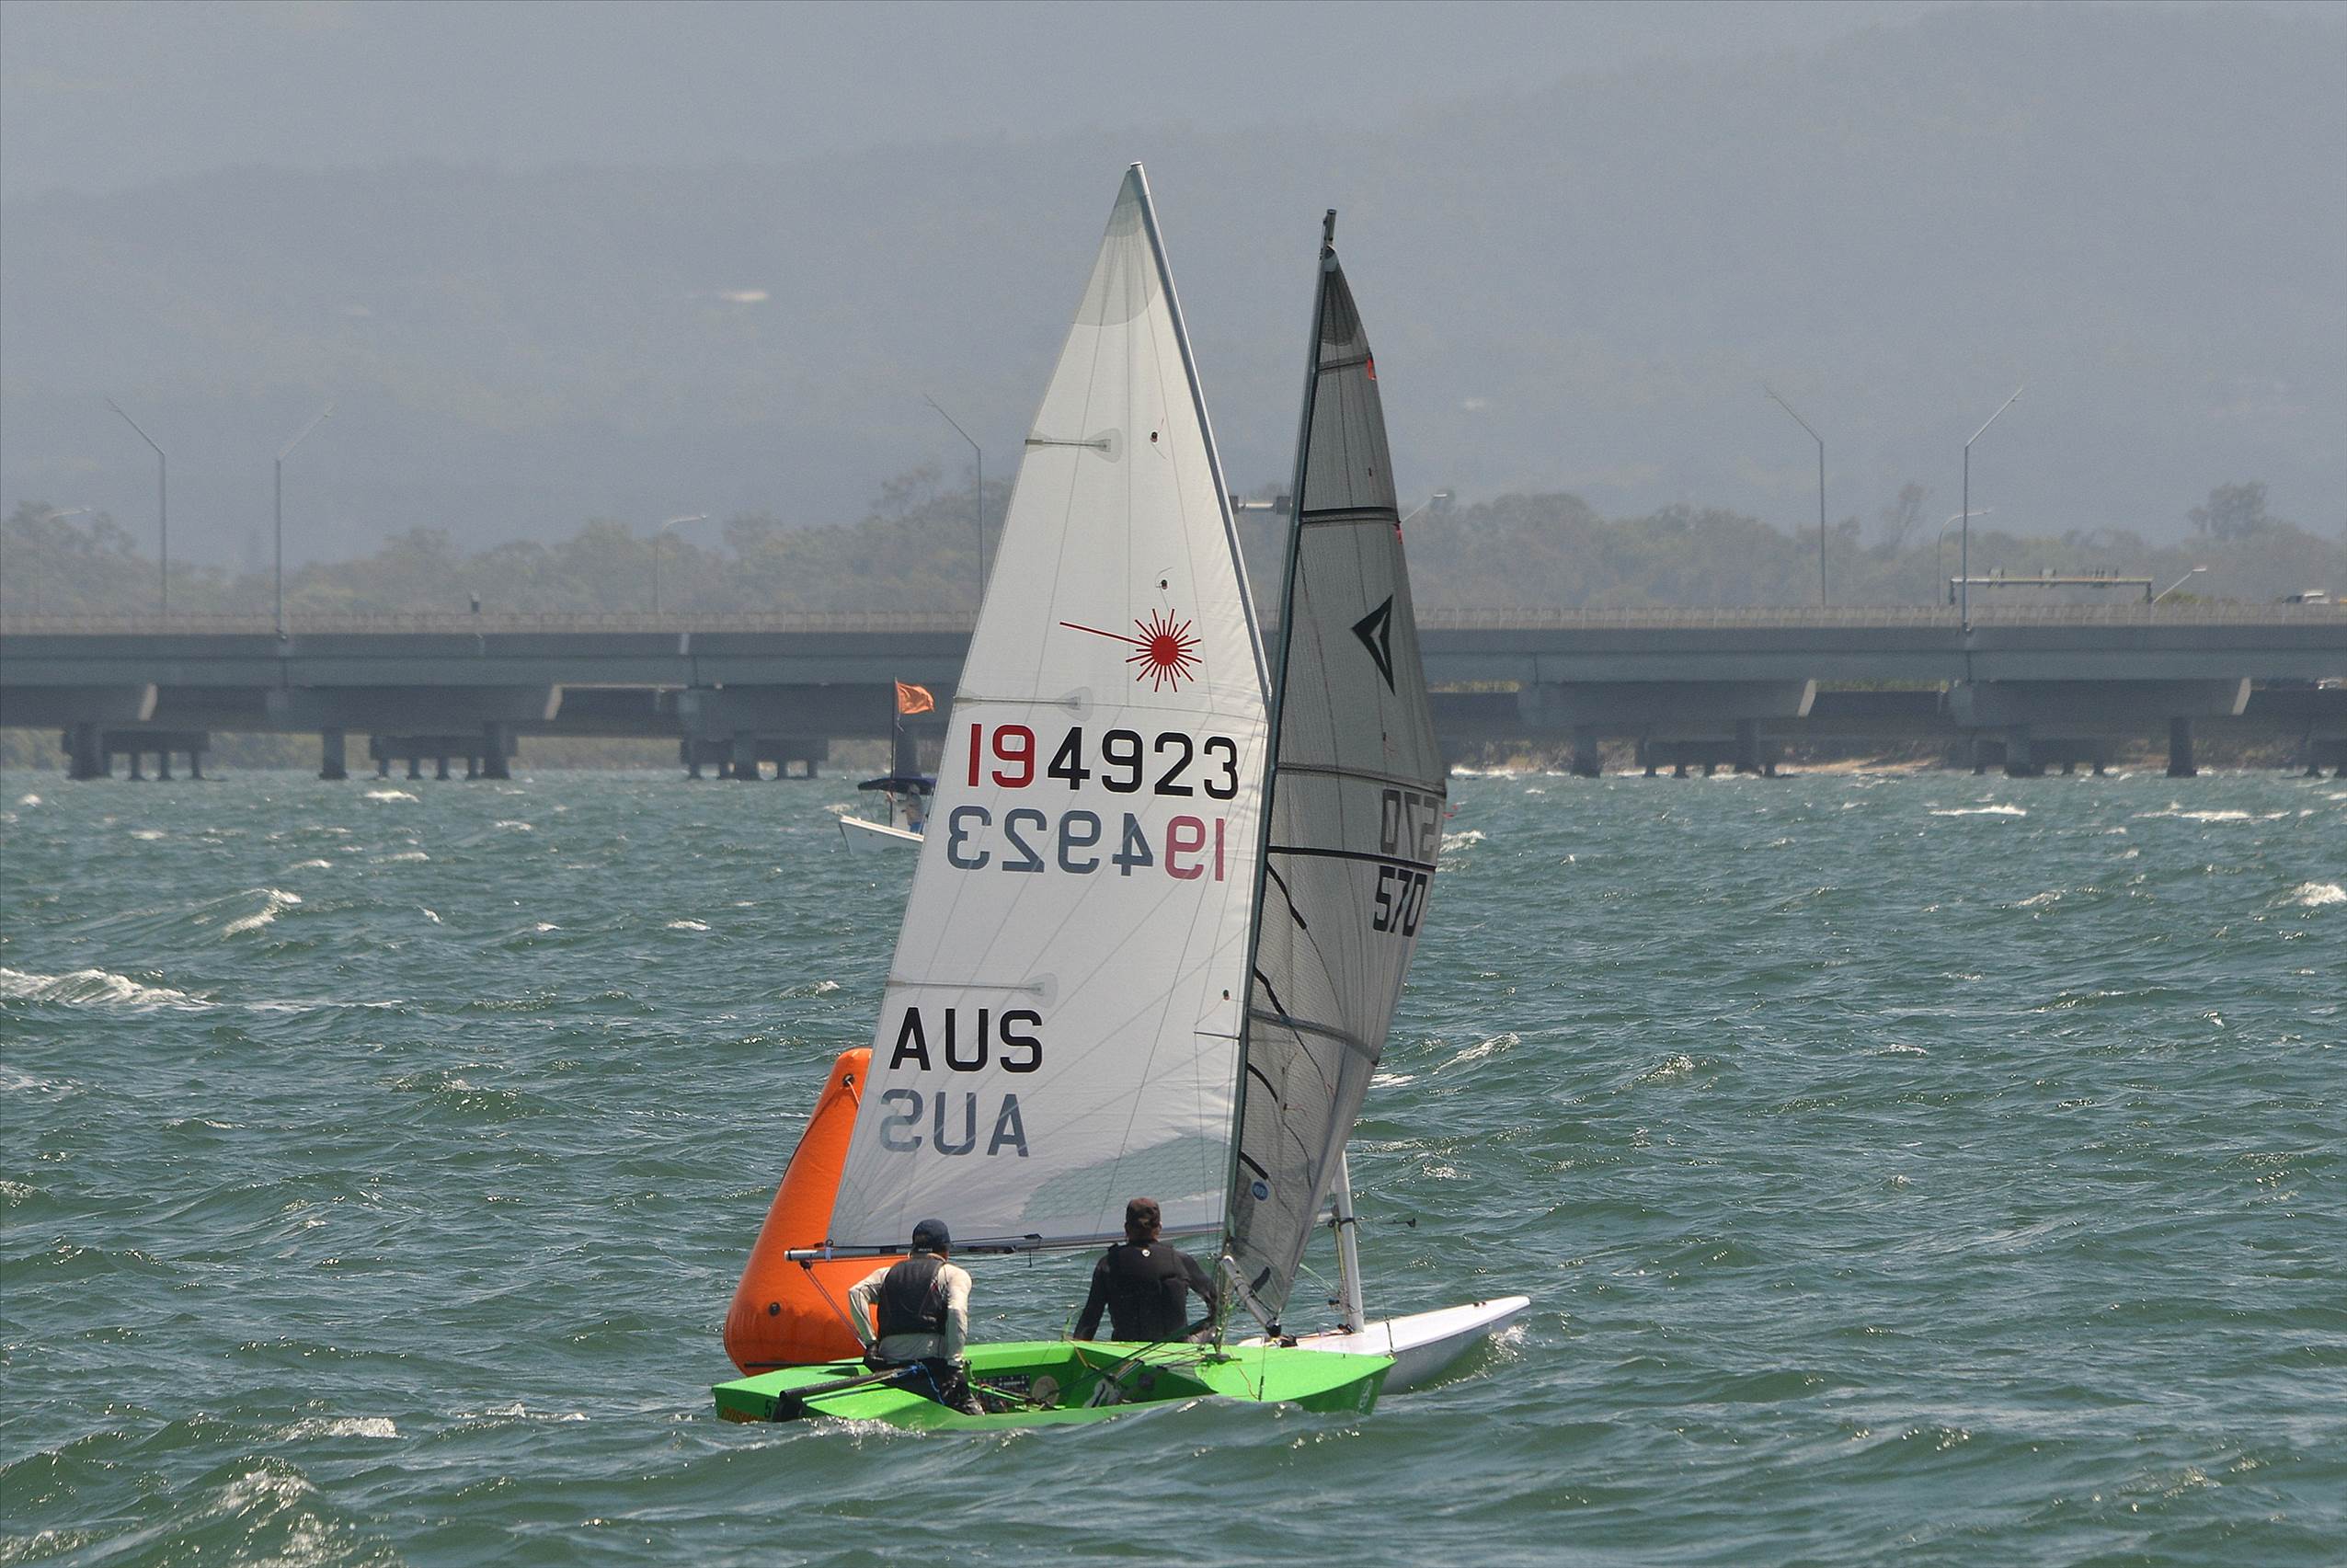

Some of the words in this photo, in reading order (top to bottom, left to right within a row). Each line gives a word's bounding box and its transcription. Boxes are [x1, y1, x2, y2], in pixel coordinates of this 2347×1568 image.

[967, 723, 1239, 800] 194923
[1373, 864, 1428, 938] 570
[888, 1006, 1043, 1073] AUS
